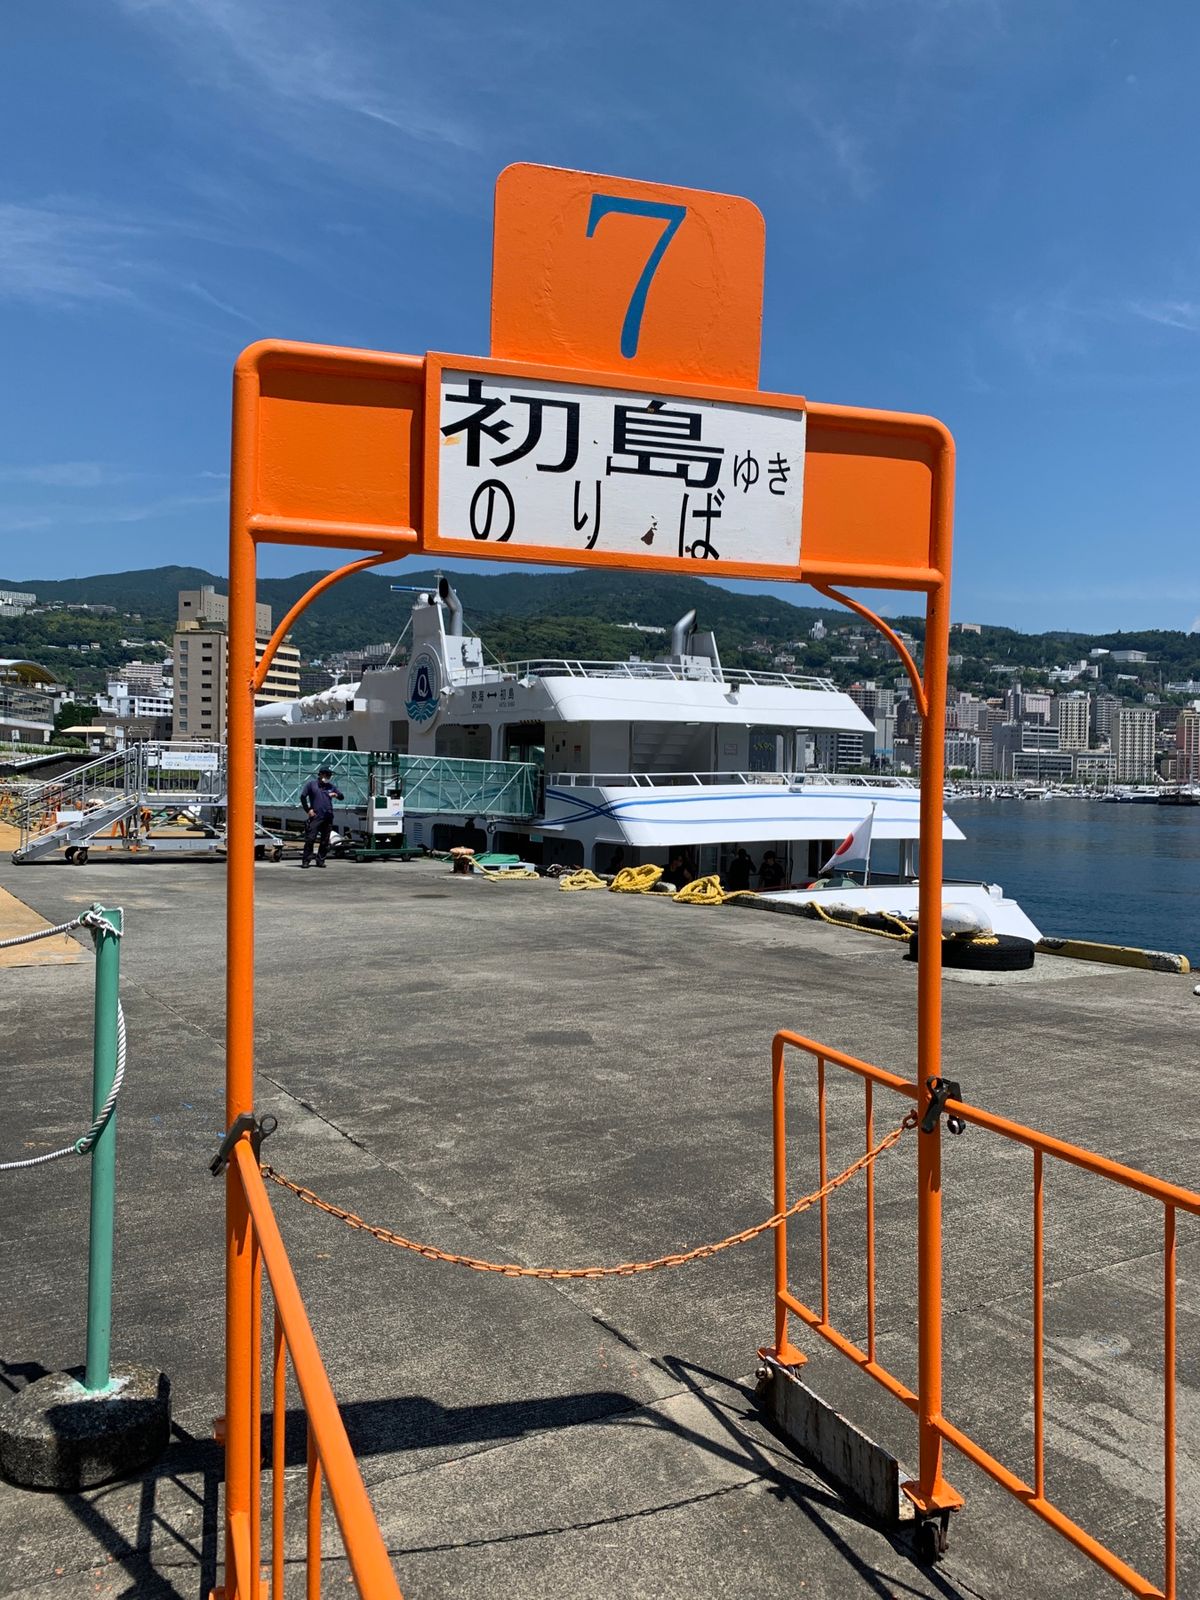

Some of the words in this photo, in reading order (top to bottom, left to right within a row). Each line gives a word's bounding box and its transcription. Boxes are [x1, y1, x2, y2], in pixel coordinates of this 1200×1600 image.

[586, 193, 687, 359] 7
[469, 479, 725, 560] のりば
